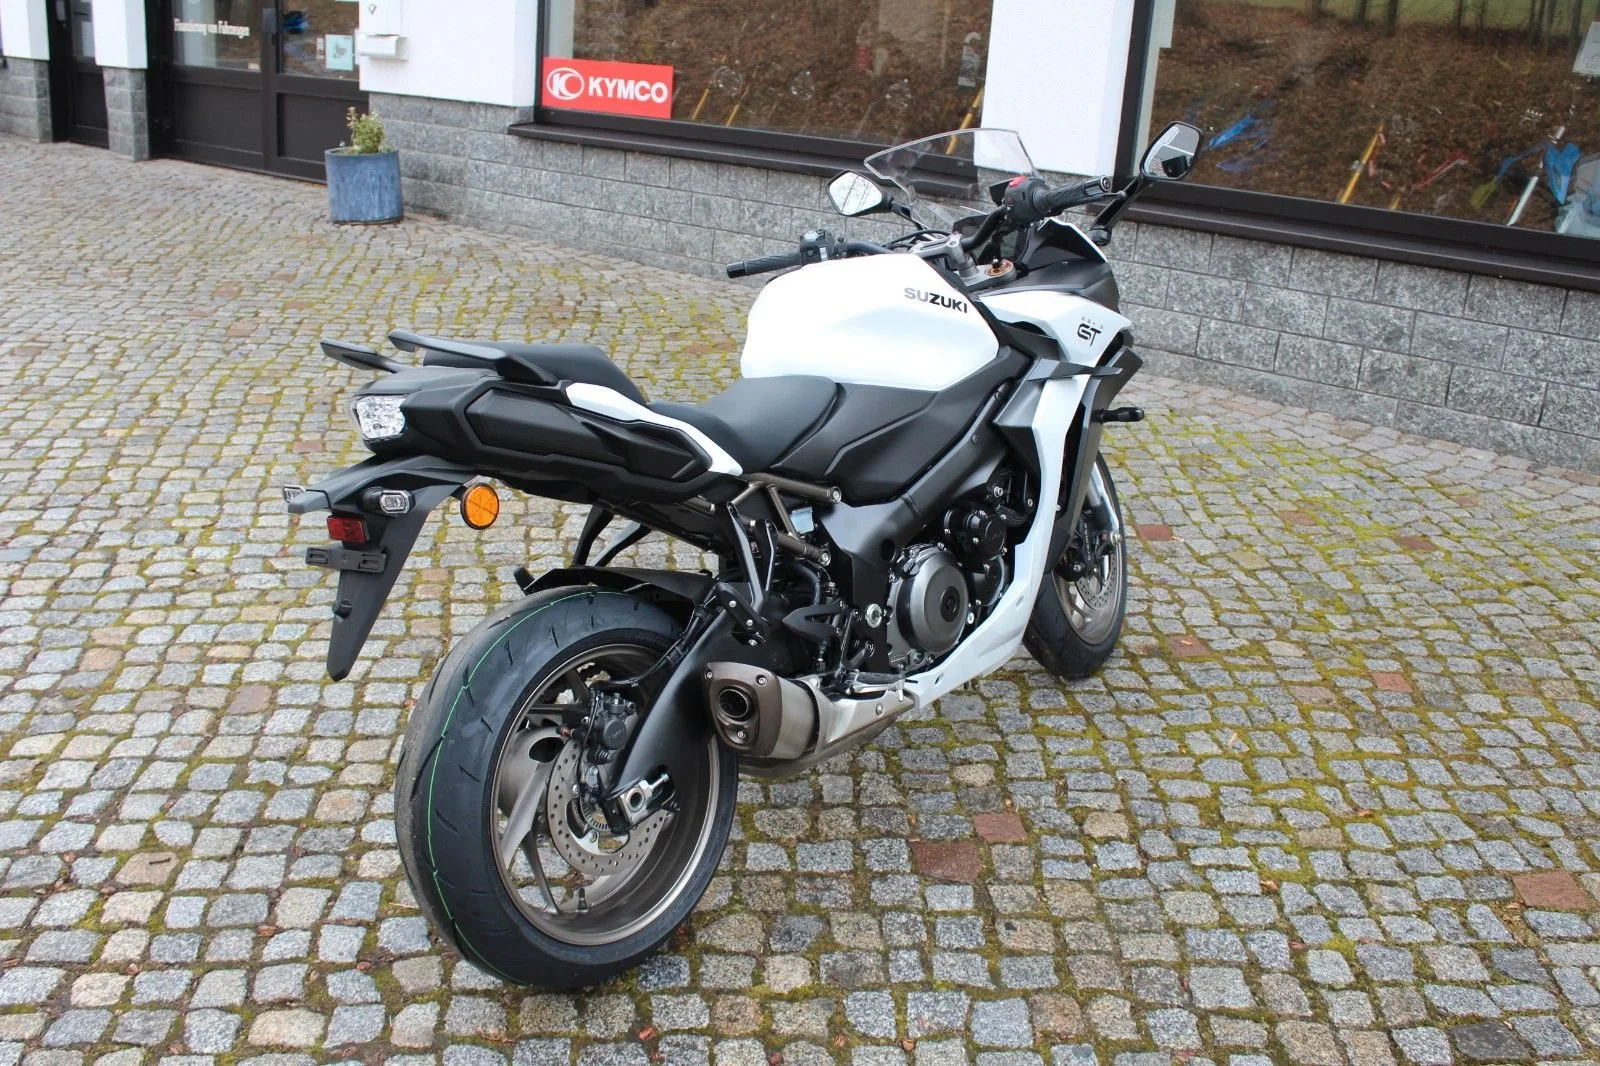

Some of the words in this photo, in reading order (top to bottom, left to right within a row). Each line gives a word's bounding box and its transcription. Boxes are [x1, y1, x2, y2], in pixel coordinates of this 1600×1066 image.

[588, 76, 668, 104] KYMCO
[903, 287, 968, 313] SUZUKI
[1077, 323, 1101, 347] GT
